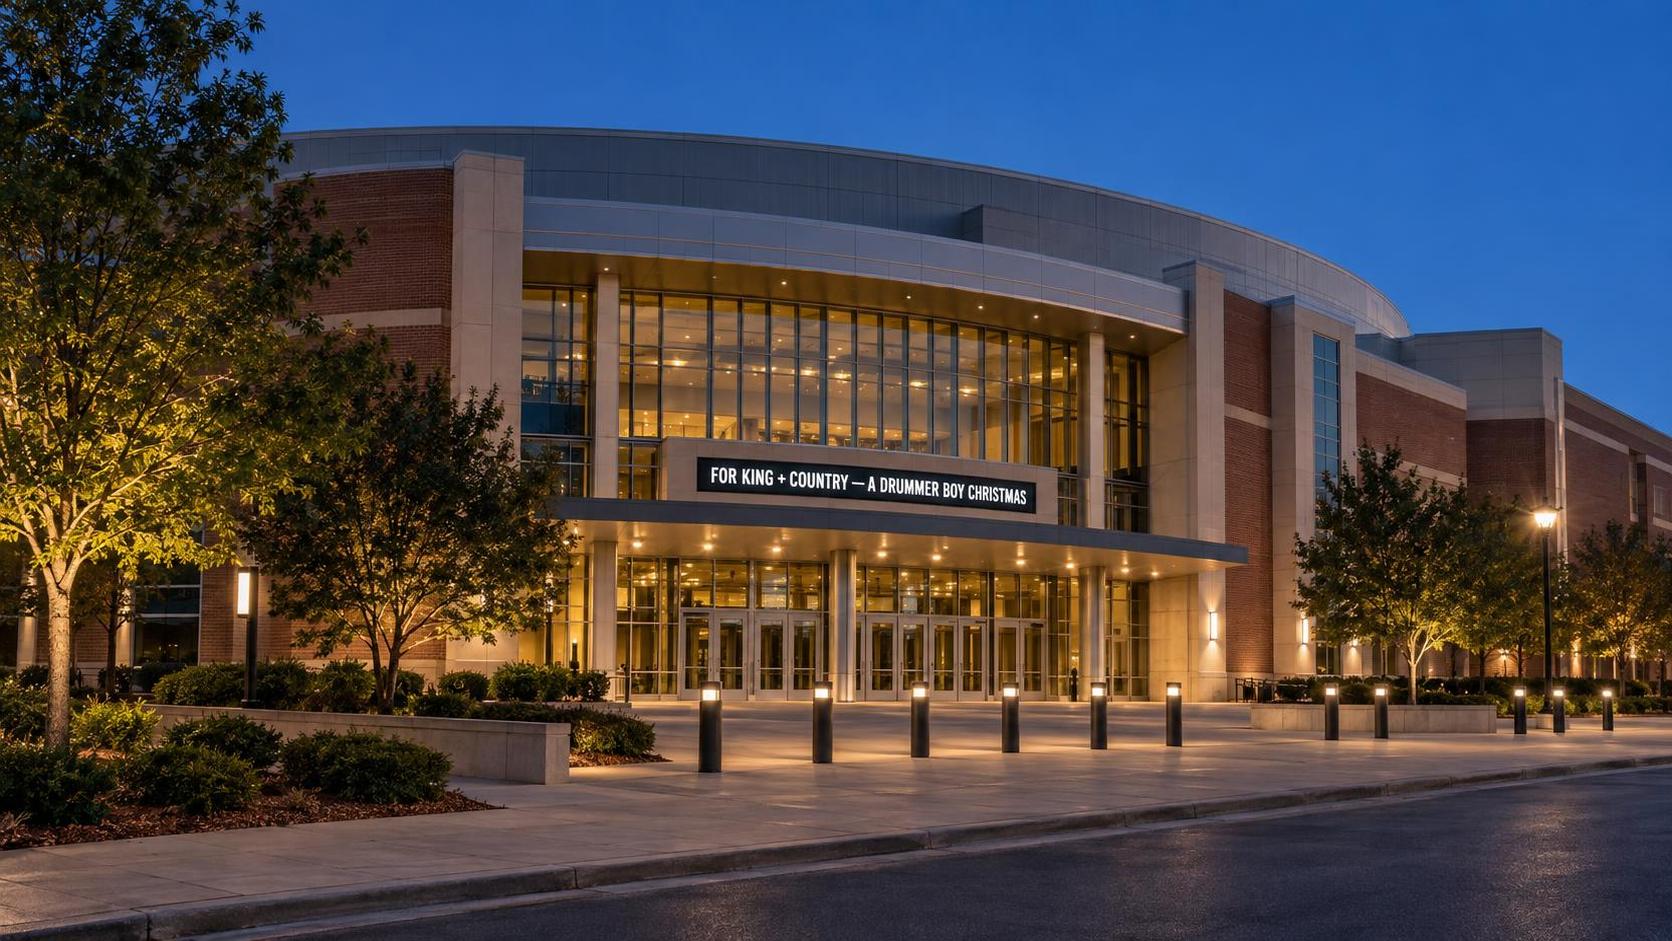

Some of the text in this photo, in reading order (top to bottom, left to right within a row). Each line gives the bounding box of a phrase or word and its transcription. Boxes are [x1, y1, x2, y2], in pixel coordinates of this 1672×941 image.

[711, 467, 737, 485] FOR
[742, 468, 774, 487] KING
[777, 474, 787, 484] +
[790, 471, 849, 491] COUNTRY
[868, 476, 877, 493] A
[880, 477, 939, 497] DRUMMER
[943, 482, 965, 499] BOY
[968, 485, 1027, 505] CHRISTMAS
